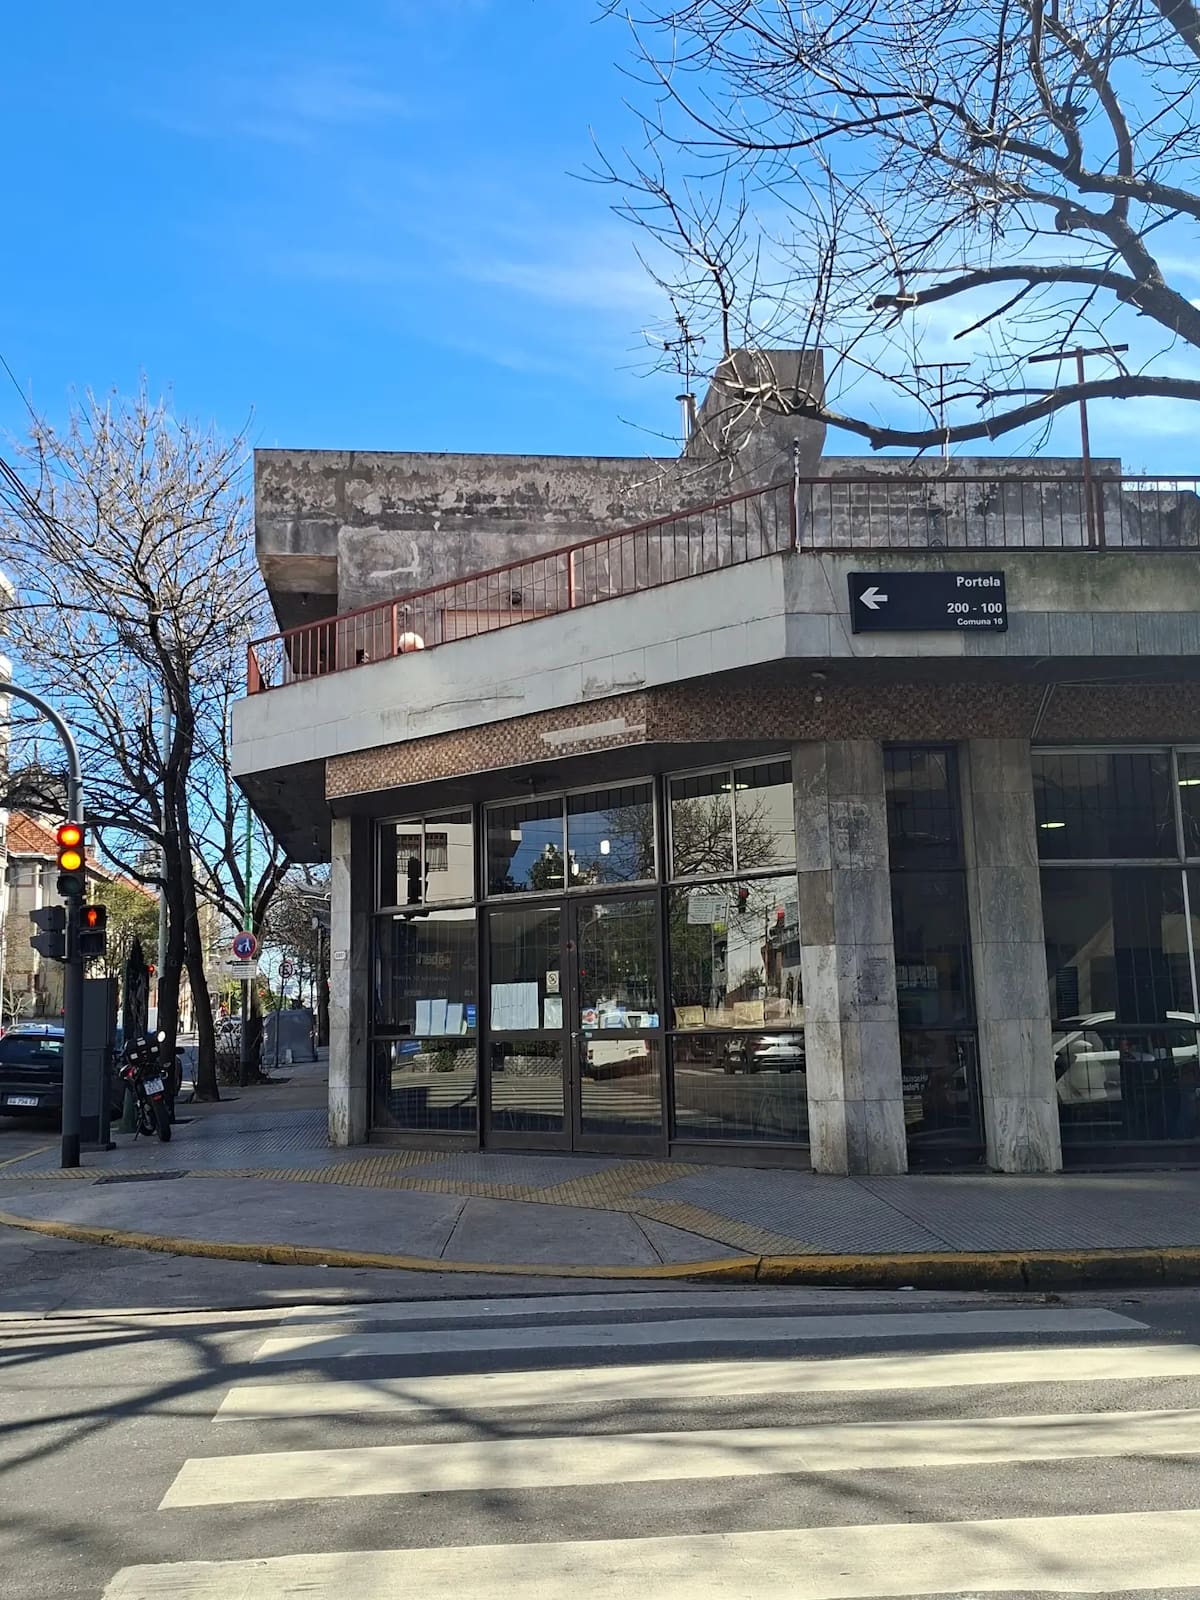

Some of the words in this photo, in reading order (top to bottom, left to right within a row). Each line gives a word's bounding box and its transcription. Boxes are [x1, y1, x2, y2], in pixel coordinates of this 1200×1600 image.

[956, 576, 1000, 587] Portela
[947, 603, 969, 613] 200
[981, 603, 1002, 613] 100
